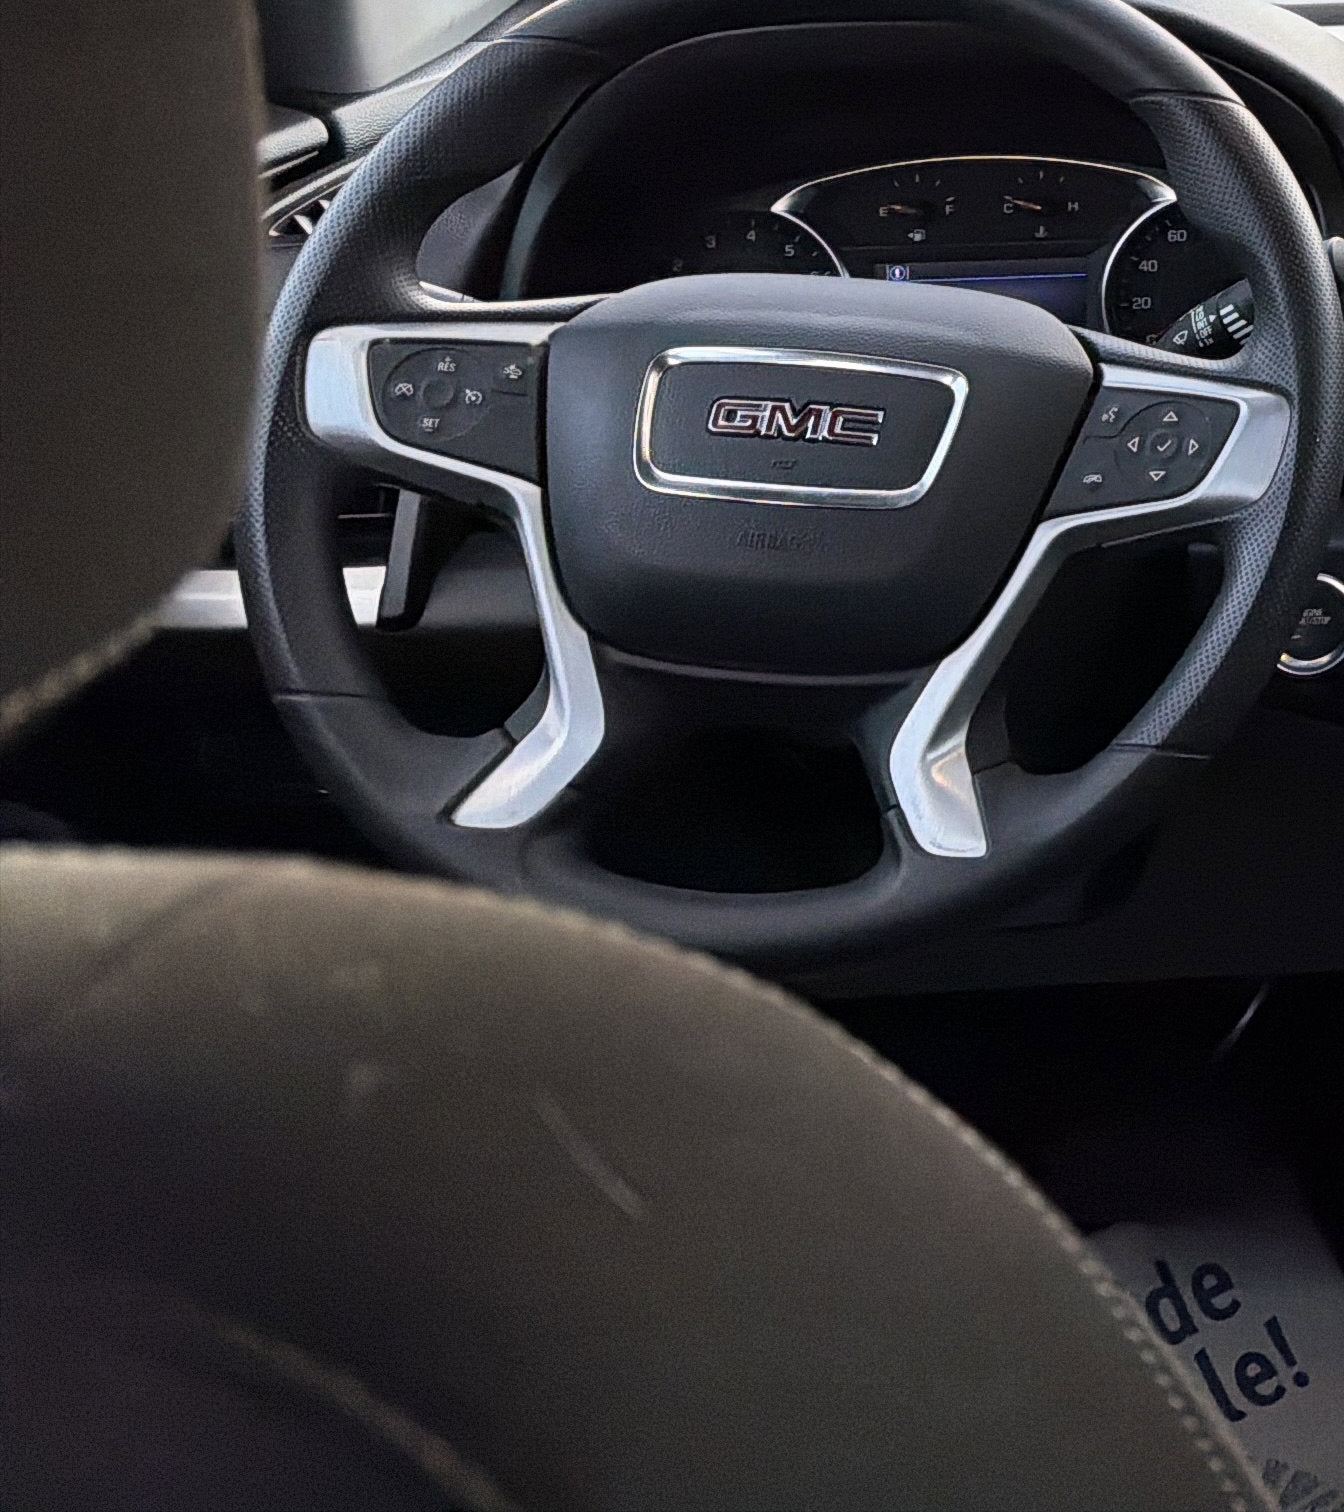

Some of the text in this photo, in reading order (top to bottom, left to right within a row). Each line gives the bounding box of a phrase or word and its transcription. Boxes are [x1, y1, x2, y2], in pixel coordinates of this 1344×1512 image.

[746, 230, 756, 243] 4
[1167, 229, 1187, 242] 60
[784, 244, 795, 257] 5
[1138, 259, 1158, 272] 40
[1132, 297, 1151, 310] 20
[422, 417, 440, 428] SET
[708, 397, 885, 446] GMC
[1145, 1258, 1242, 1346] de
[1193, 1315, 1310, 1423] le!
